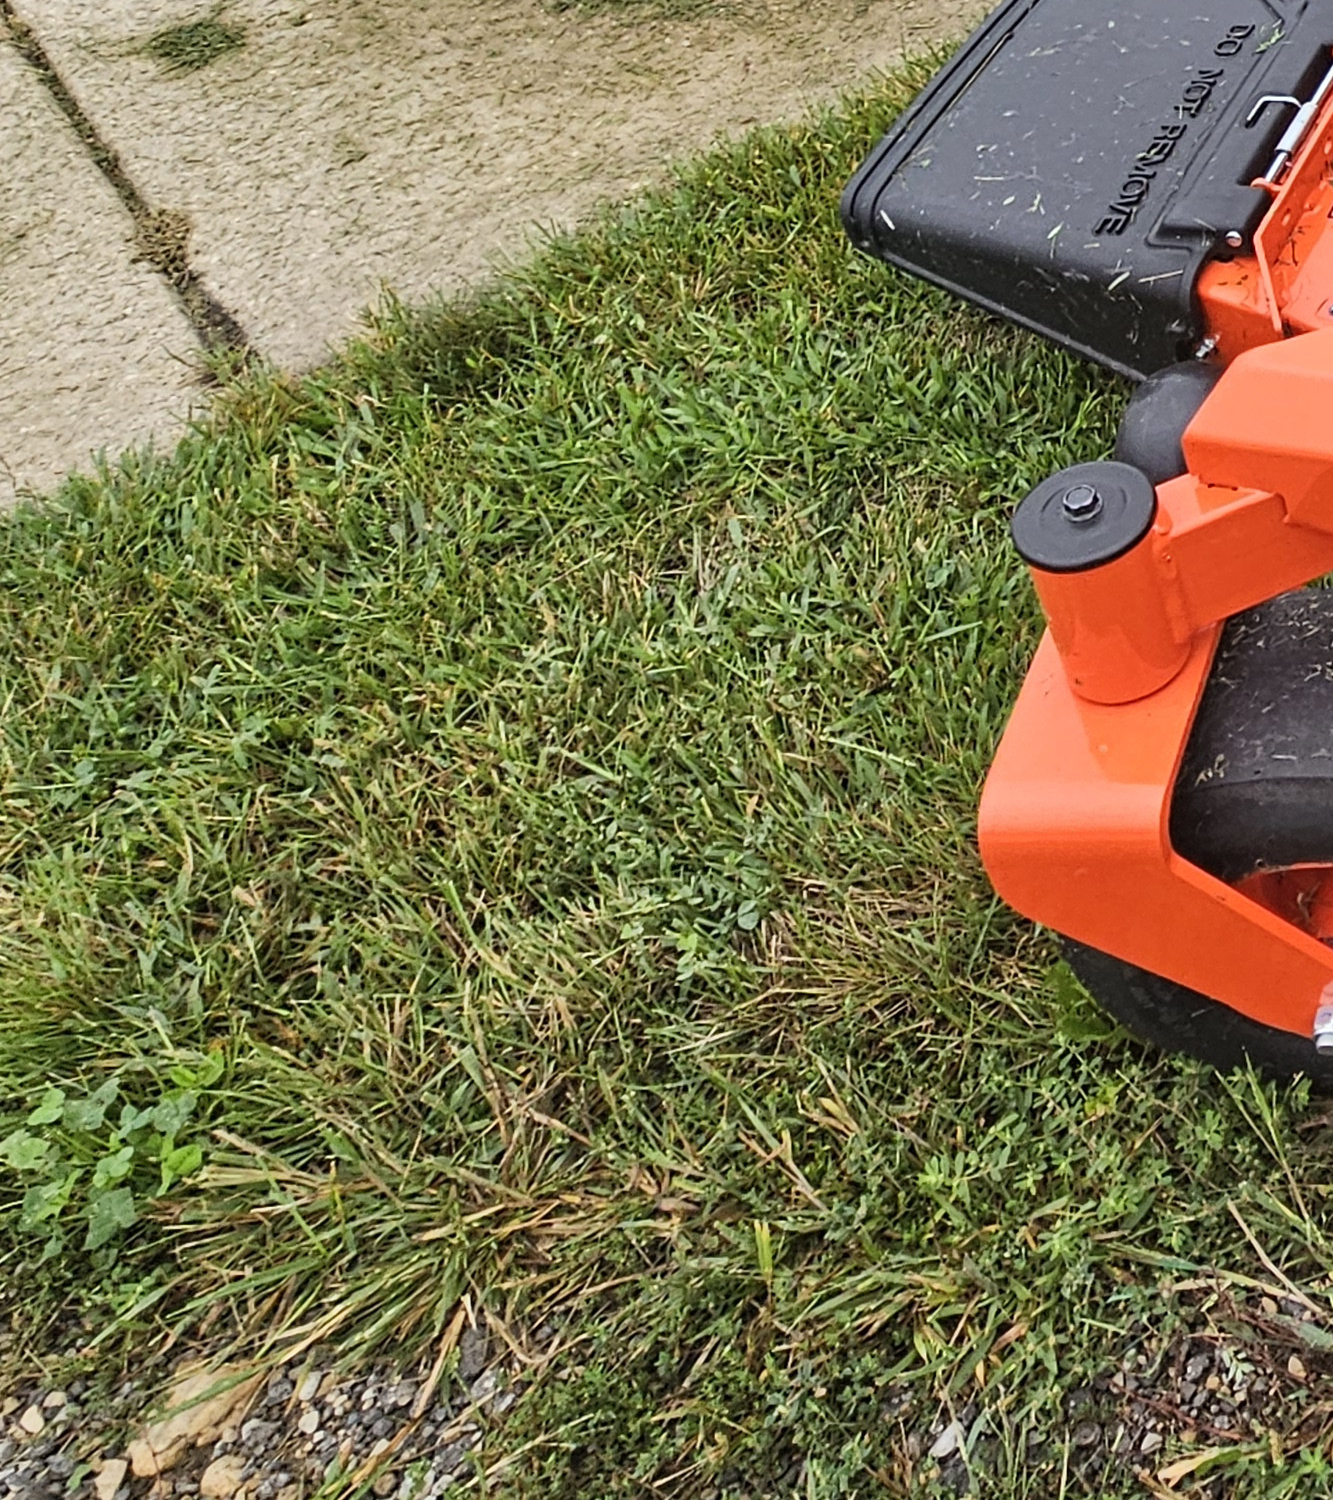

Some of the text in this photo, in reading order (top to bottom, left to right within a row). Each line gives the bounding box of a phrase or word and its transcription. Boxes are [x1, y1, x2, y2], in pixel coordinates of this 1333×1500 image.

[1213, 24, 1256, 57] DO
[1173, 68, 1224, 119] NOT
[1093, 123, 1188, 235] REMOVE
